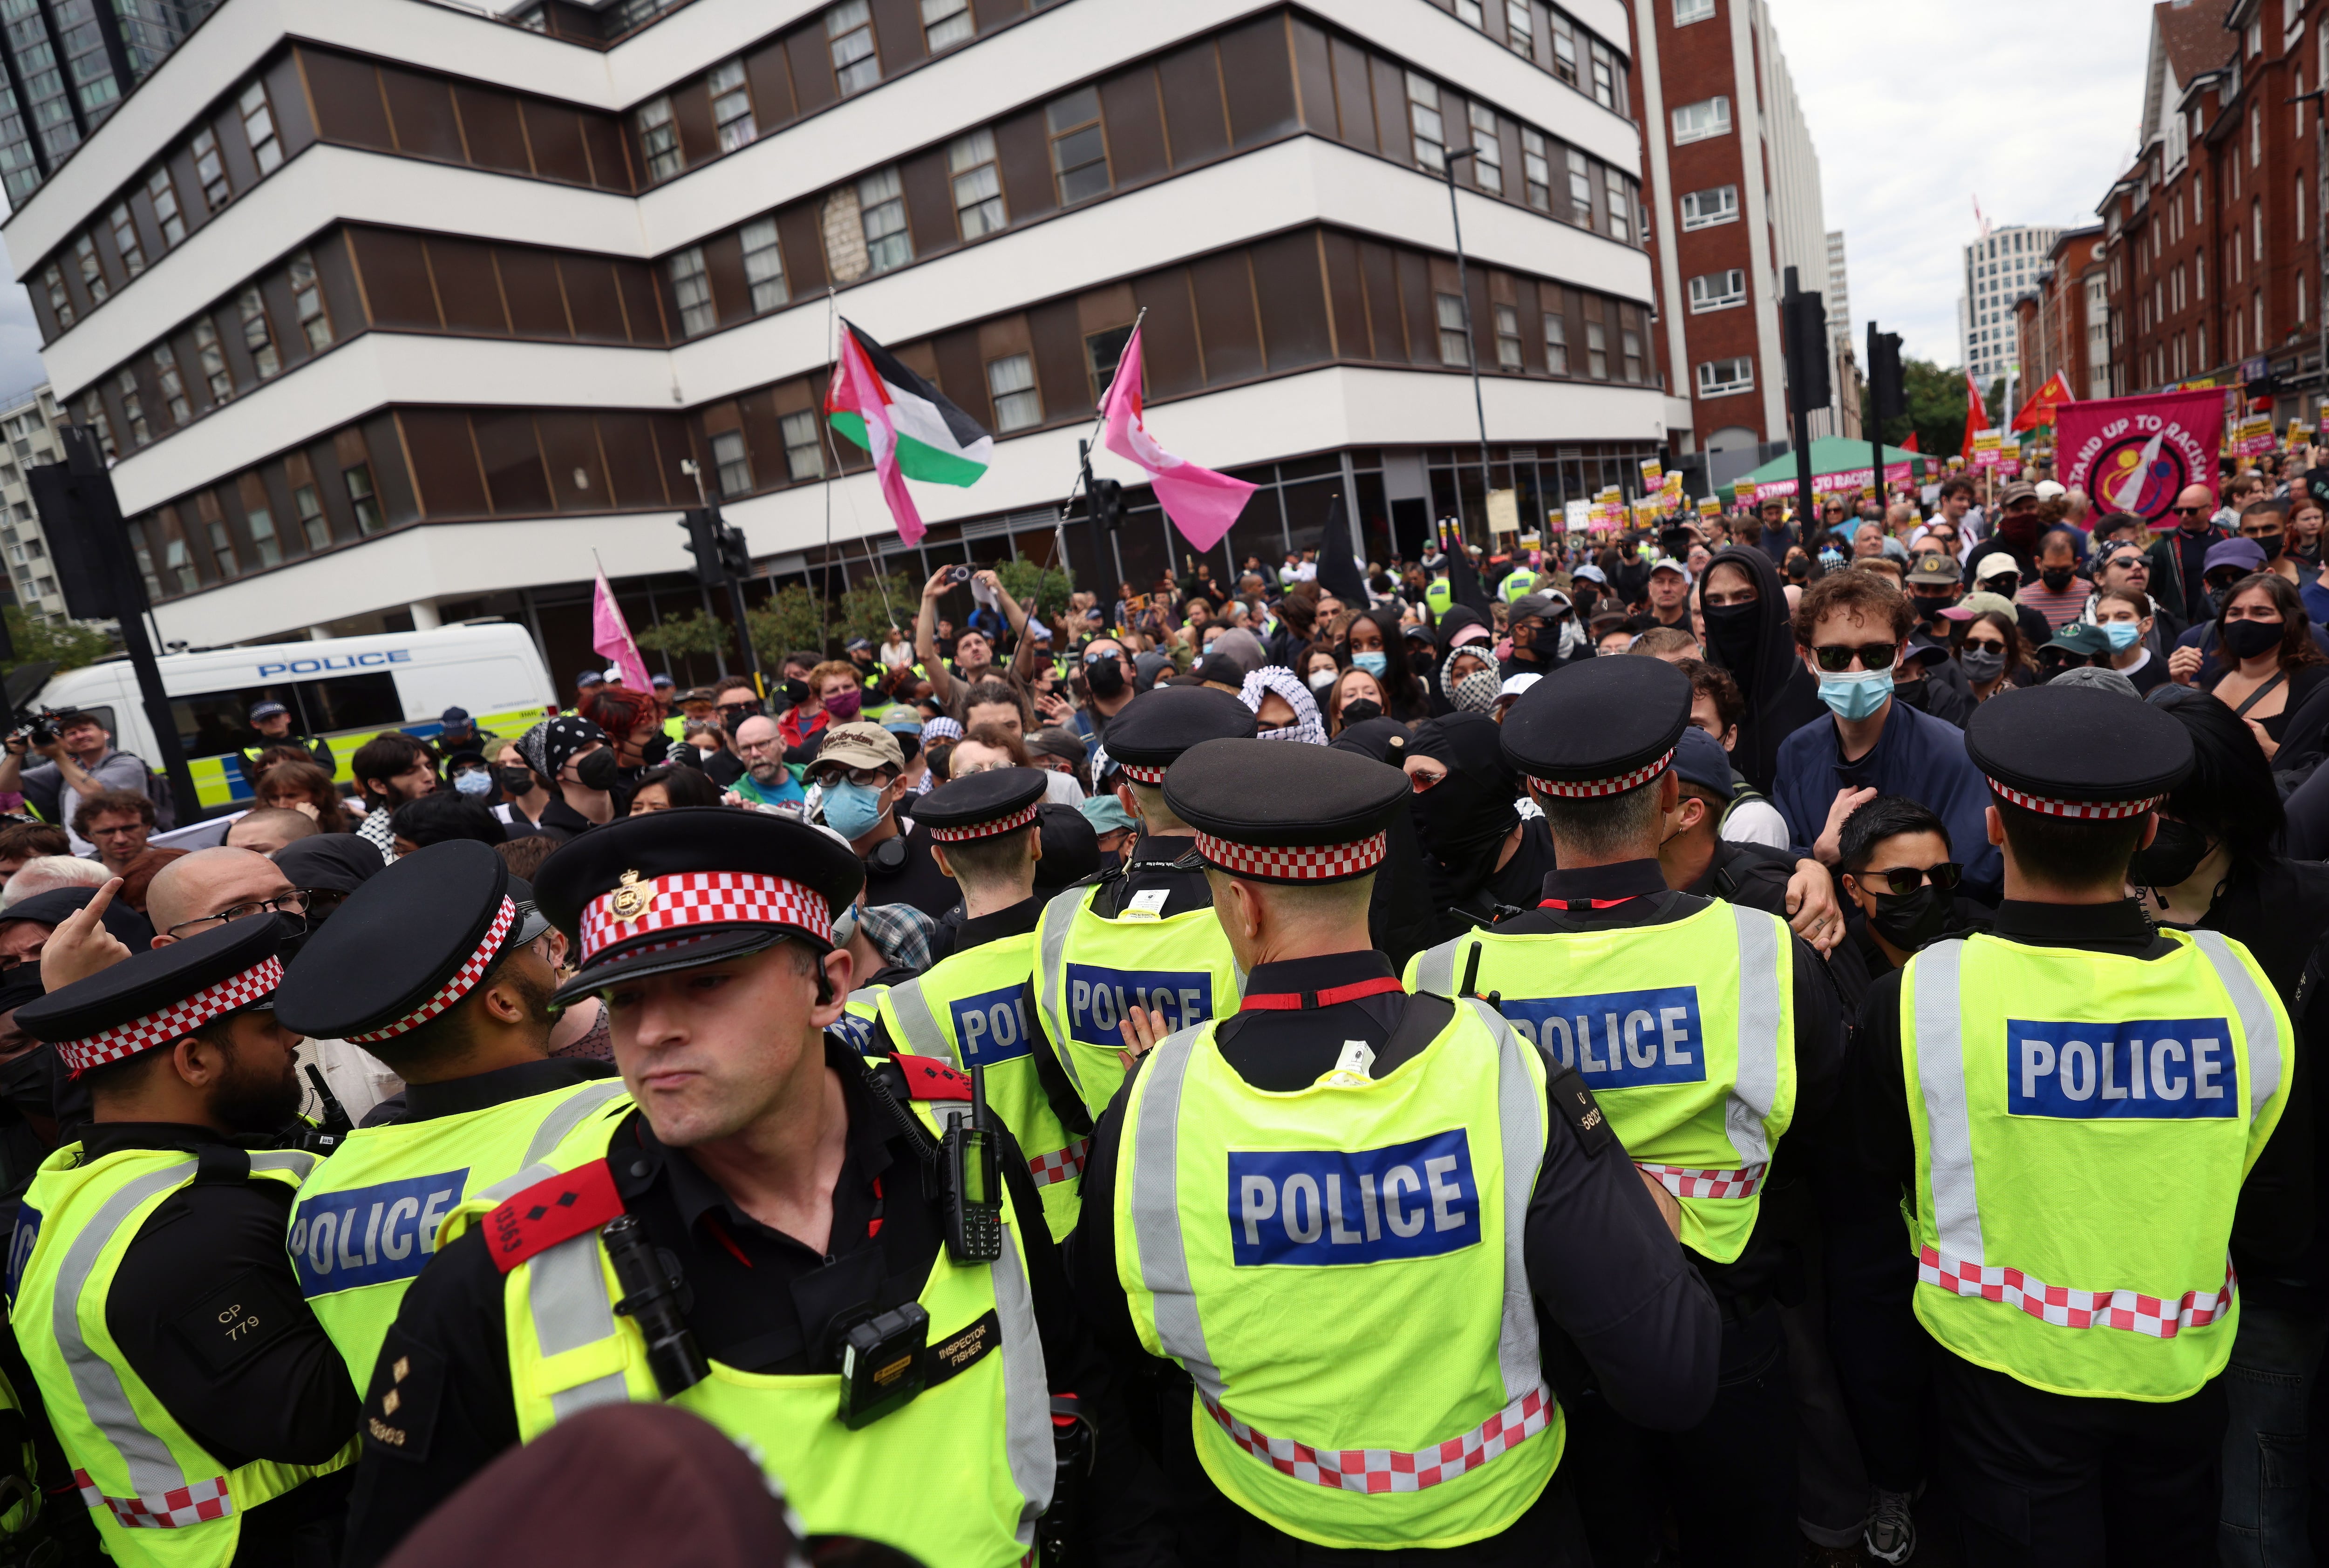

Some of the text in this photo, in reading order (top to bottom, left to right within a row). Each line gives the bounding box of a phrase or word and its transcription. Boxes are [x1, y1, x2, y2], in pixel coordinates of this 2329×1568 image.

[2101, 417, 2130, 439] UP
[2135, 414, 2163, 432] TO
[2164, 421, 2207, 483] RACISM
[1756, 482, 1795, 499] STAND
[258, 649, 411, 677] POLICE
[1073, 979, 1200, 1035] POLICE
[961, 998, 1031, 1054] POL
[2021, 1038, 2224, 1101] POLICE
[1576, 1092, 1587, 1105] U
[1241, 1154, 1466, 1245] POLICE
[291, 1188, 452, 1275] POLICE
[218, 1304, 241, 1323] CP
[225, 1316, 259, 1341] 779
[939, 1324, 986, 1360] INSPECTOR
[951, 1341, 982, 1367] FISHER
